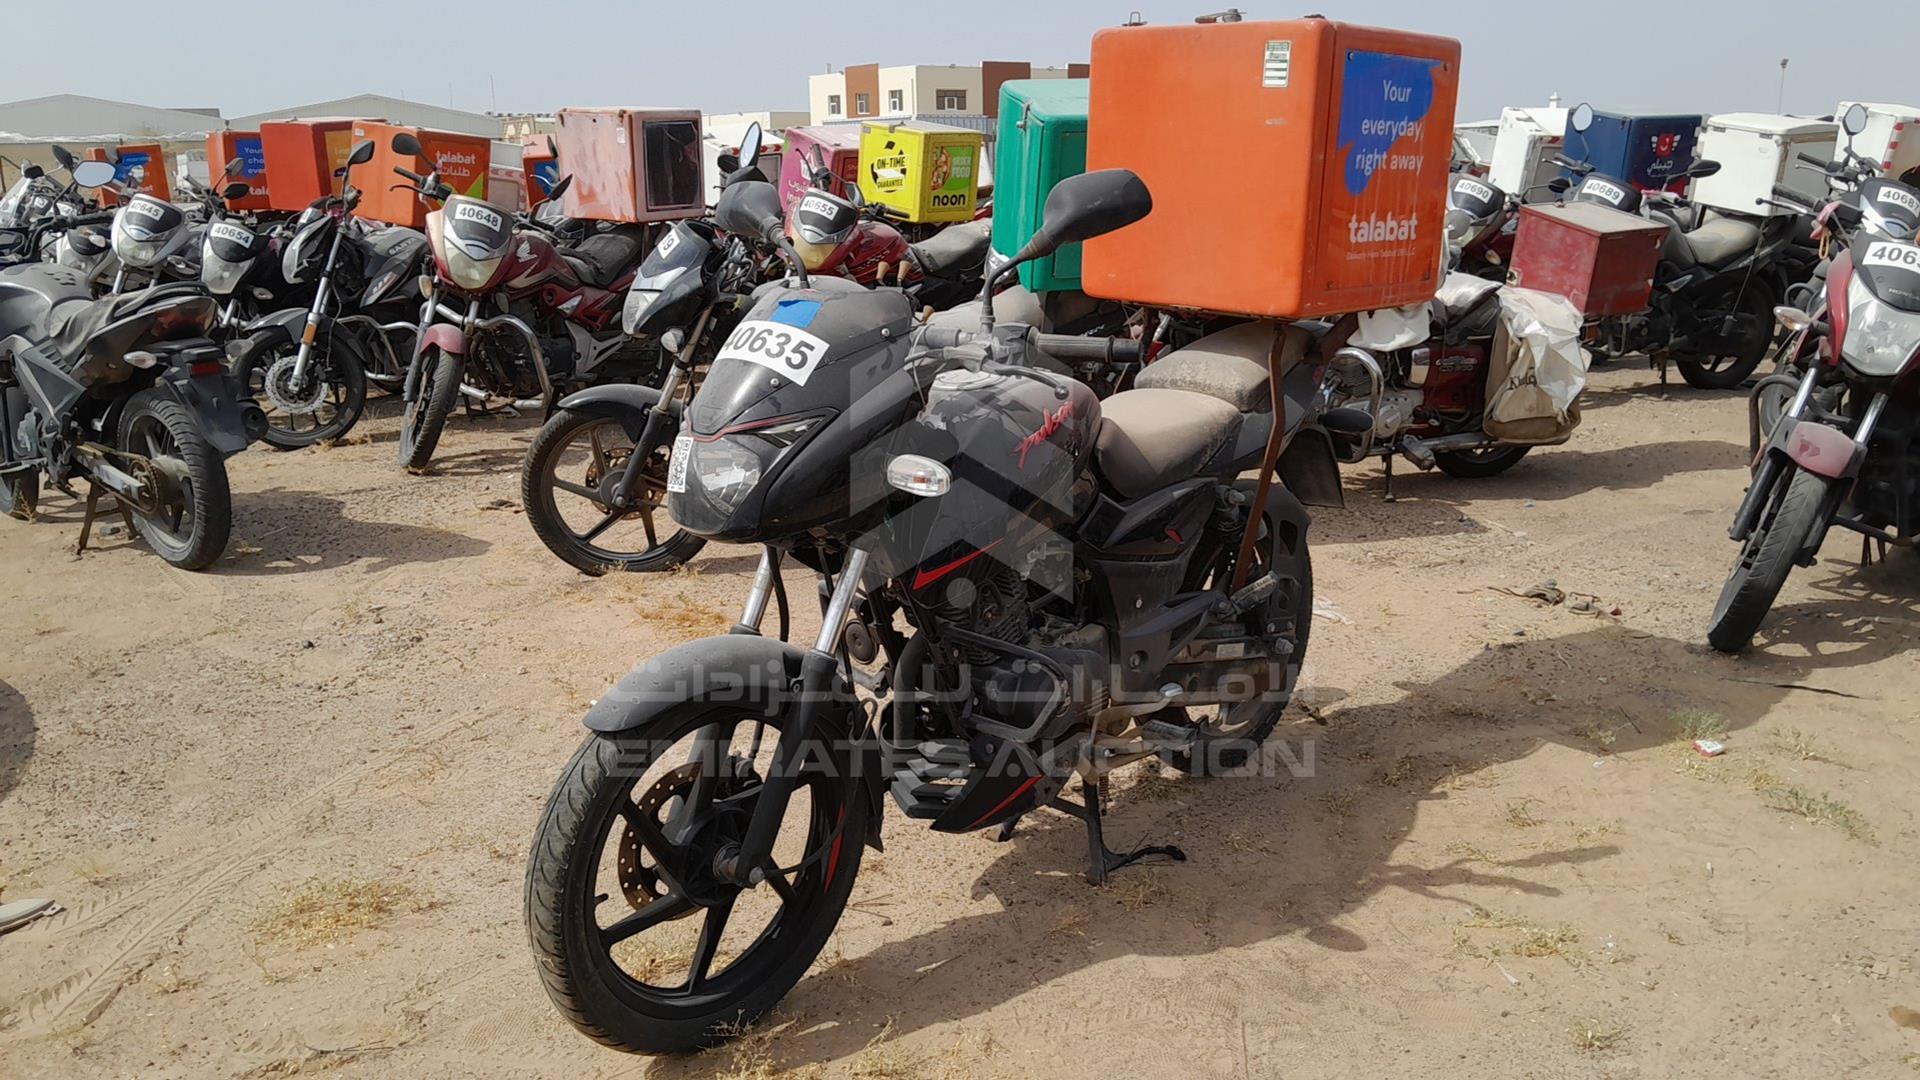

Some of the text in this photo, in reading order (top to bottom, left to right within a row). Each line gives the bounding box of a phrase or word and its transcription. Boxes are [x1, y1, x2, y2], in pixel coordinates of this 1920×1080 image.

[1382, 79, 1412, 102] Your
[1361, 116, 1425, 143] everyday,
[435, 151, 476, 164] talabat
[877, 156, 906, 169] ON-TIME
[1355, 147, 1424, 176] right away
[932, 194, 966, 206] noon
[1458, 181, 1489, 200] 40690
[1586, 181, 1621, 201] 40689
[1881, 189, 1920, 211] 40687
[458, 206, 499, 228] 40648
[804, 199, 835, 216] 40655
[214, 226, 251, 244] 40654
[1348, 211, 1418, 244] talabat
[1872, 245, 1920, 267] 406
[725, 326, 816, 370] 40635
